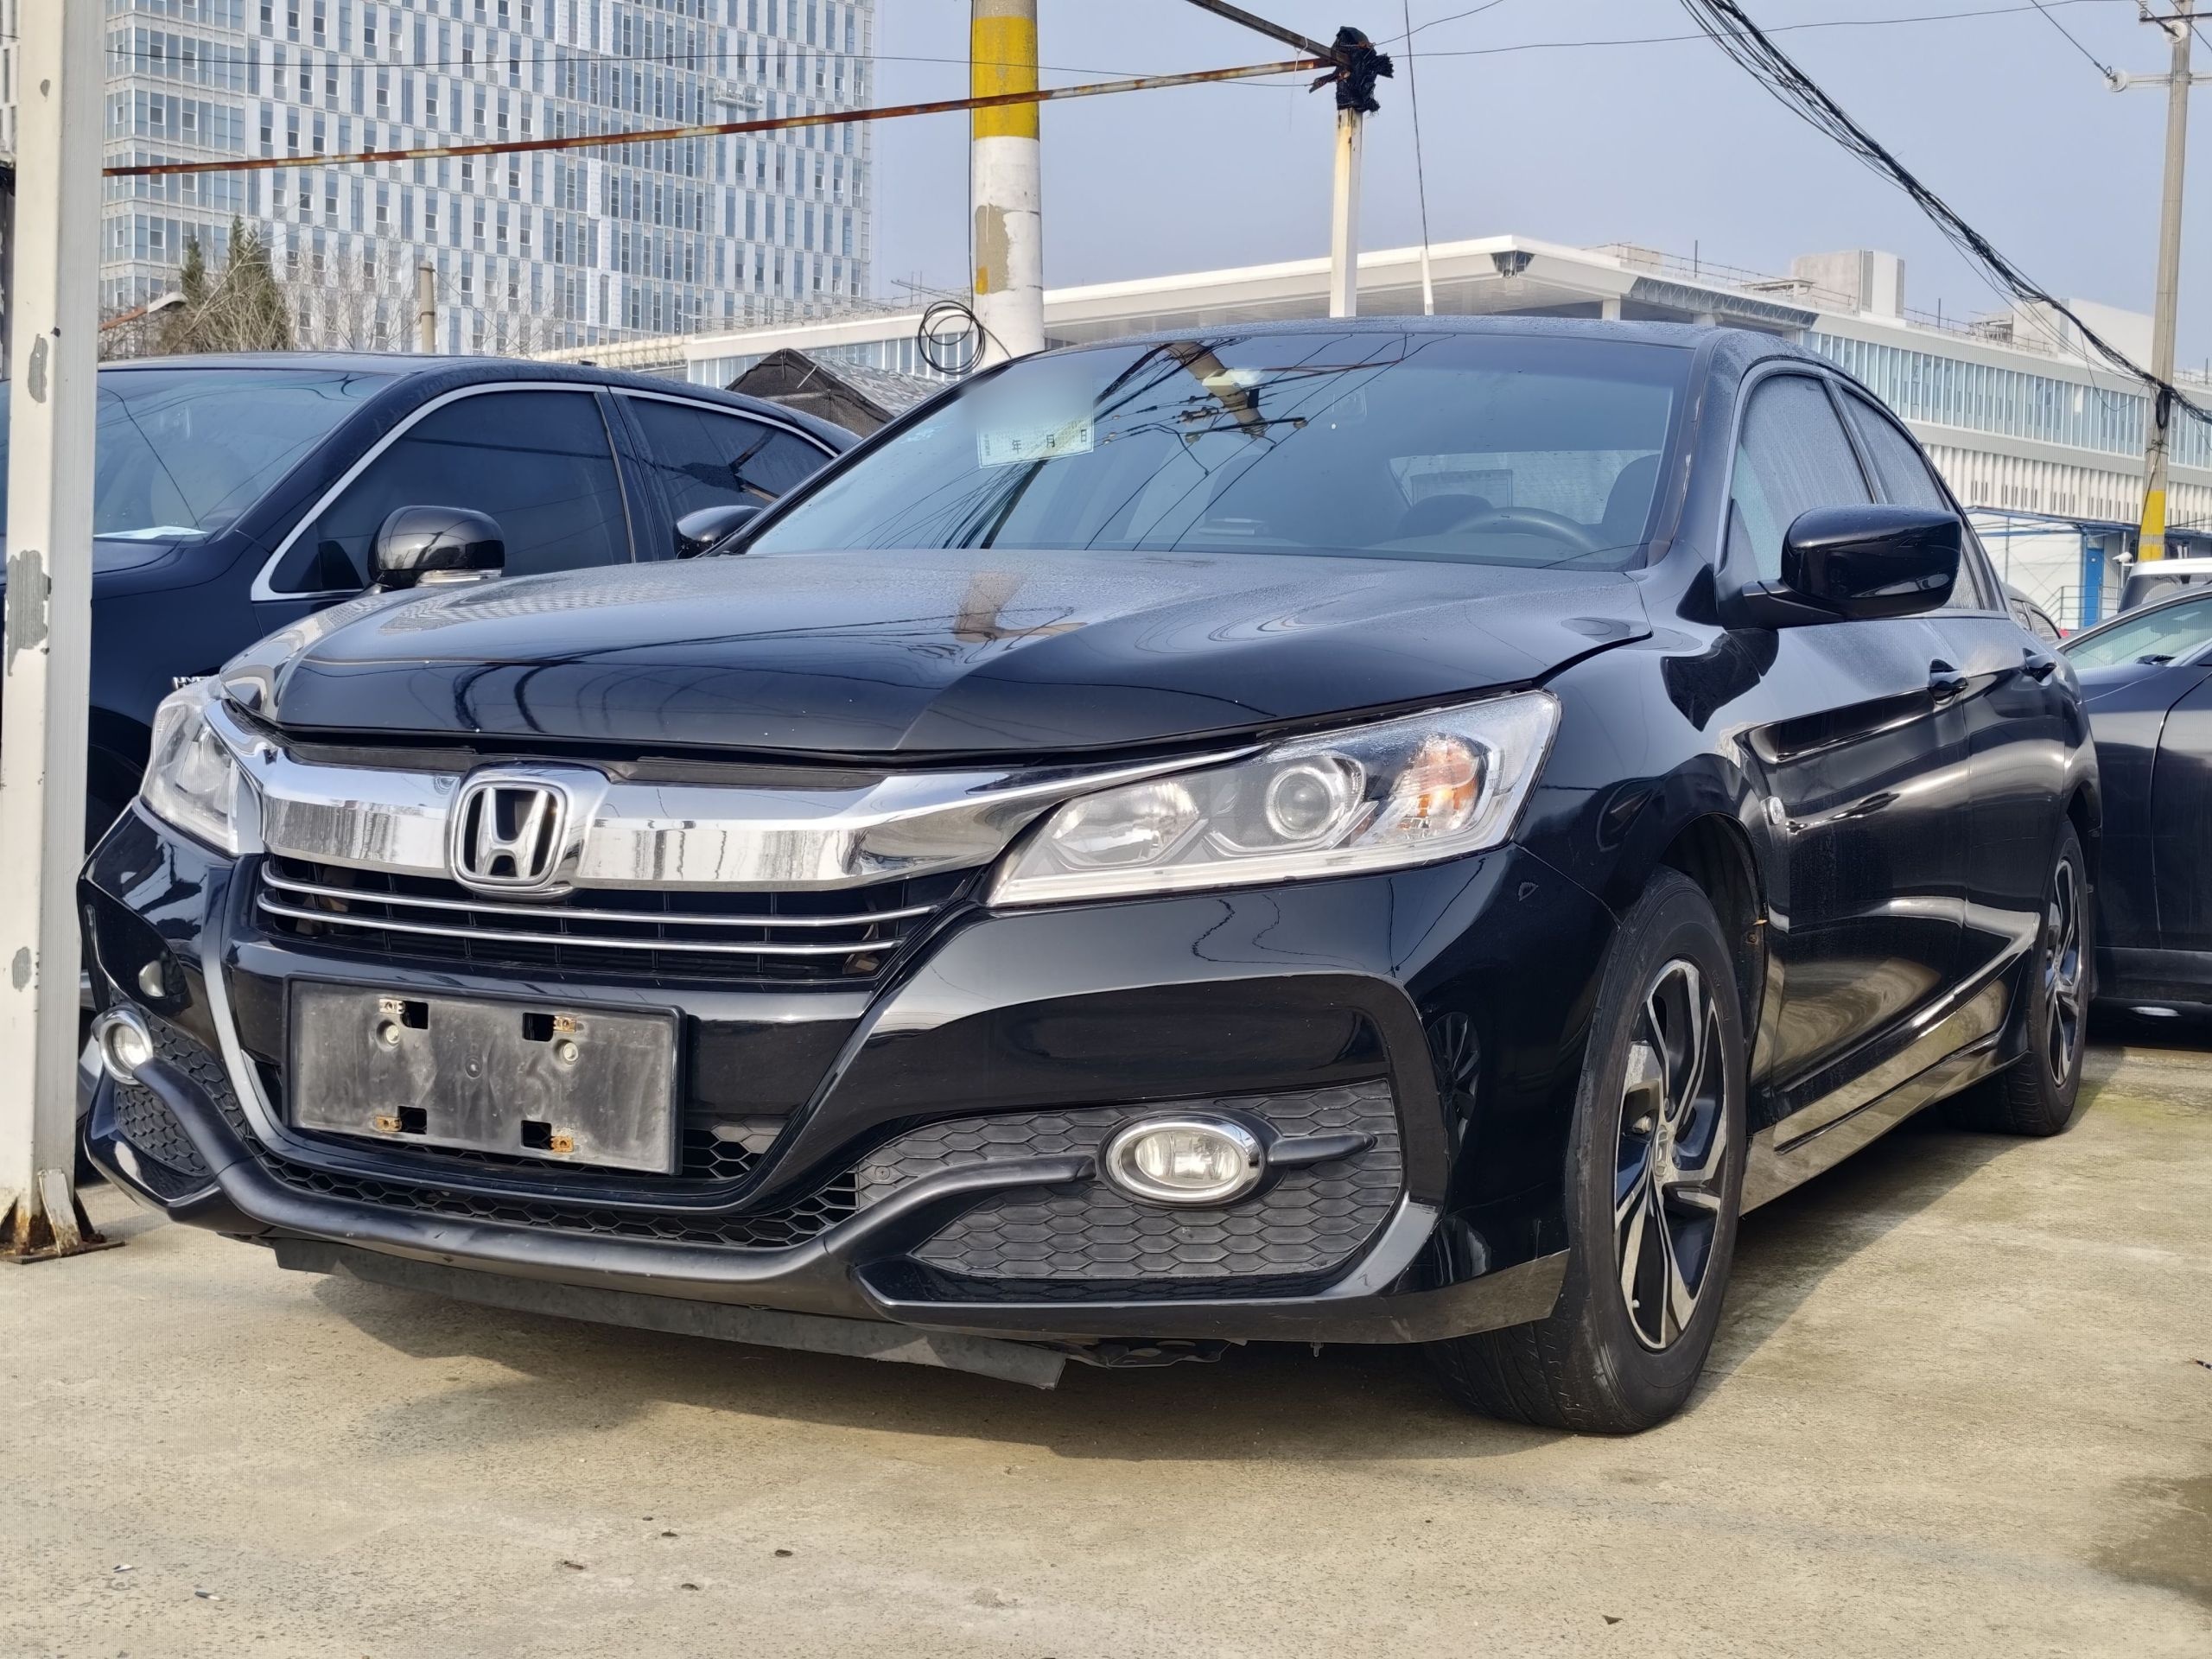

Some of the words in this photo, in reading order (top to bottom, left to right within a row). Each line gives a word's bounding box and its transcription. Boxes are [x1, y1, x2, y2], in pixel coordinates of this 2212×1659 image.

[1011, 439, 1022, 454] 年
[1046, 434, 1056, 448] 月
[1080, 429, 1087, 442] 日
